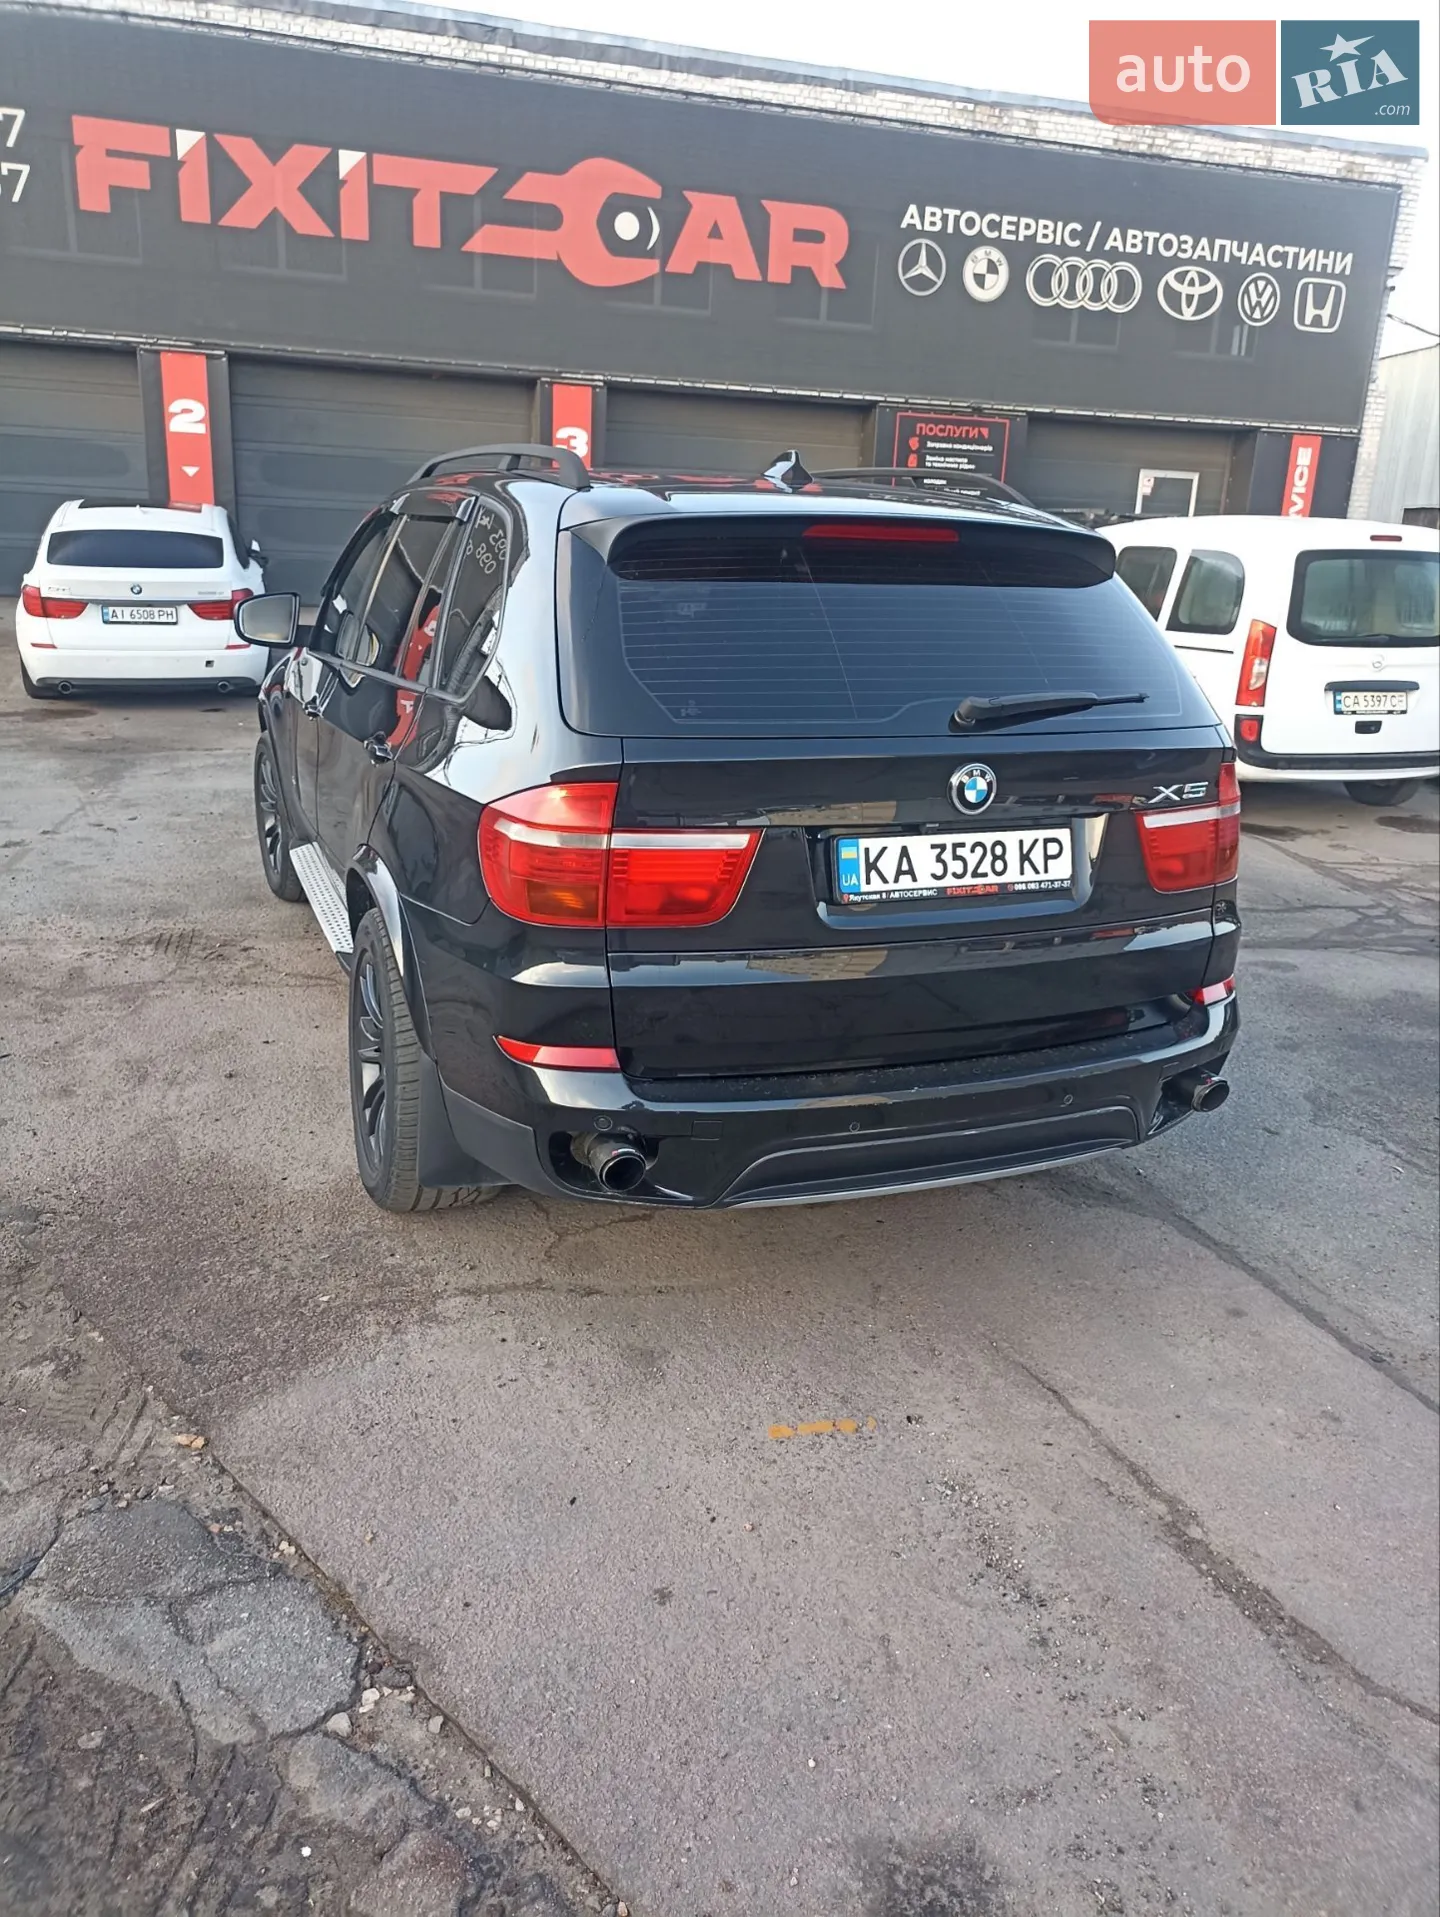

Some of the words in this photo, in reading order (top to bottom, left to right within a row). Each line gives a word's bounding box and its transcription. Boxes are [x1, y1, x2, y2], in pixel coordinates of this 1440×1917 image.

[0, 162, 31, 203] 7
[900, 204, 1083, 248] АВТОСЕРВІС
[1103, 227, 1354, 276] АВТОЗАПЧАСТИНИ
[168, 398, 206, 434] 2
[556, 426, 588, 458] 3
[916, 423, 979, 438] ПОСЛУГИ
[1288, 446, 1313, 518] VICE
[129, 609, 156, 620] 6508
[158, 610, 174, 620] PH
[1343, 695, 1360, 708] CA
[1363, 695, 1388, 708] 5397
[961, 769, 992, 784] BMW
[1148, 781, 1209, 804] X5
[864, 845, 918, 885] KA
[930, 839, 1008, 881] 3528
[1018, 837, 1064, 876] KP
[842, 873, 859, 886] UA
[889, 888, 938, 899] АВТОСЕРВИС
